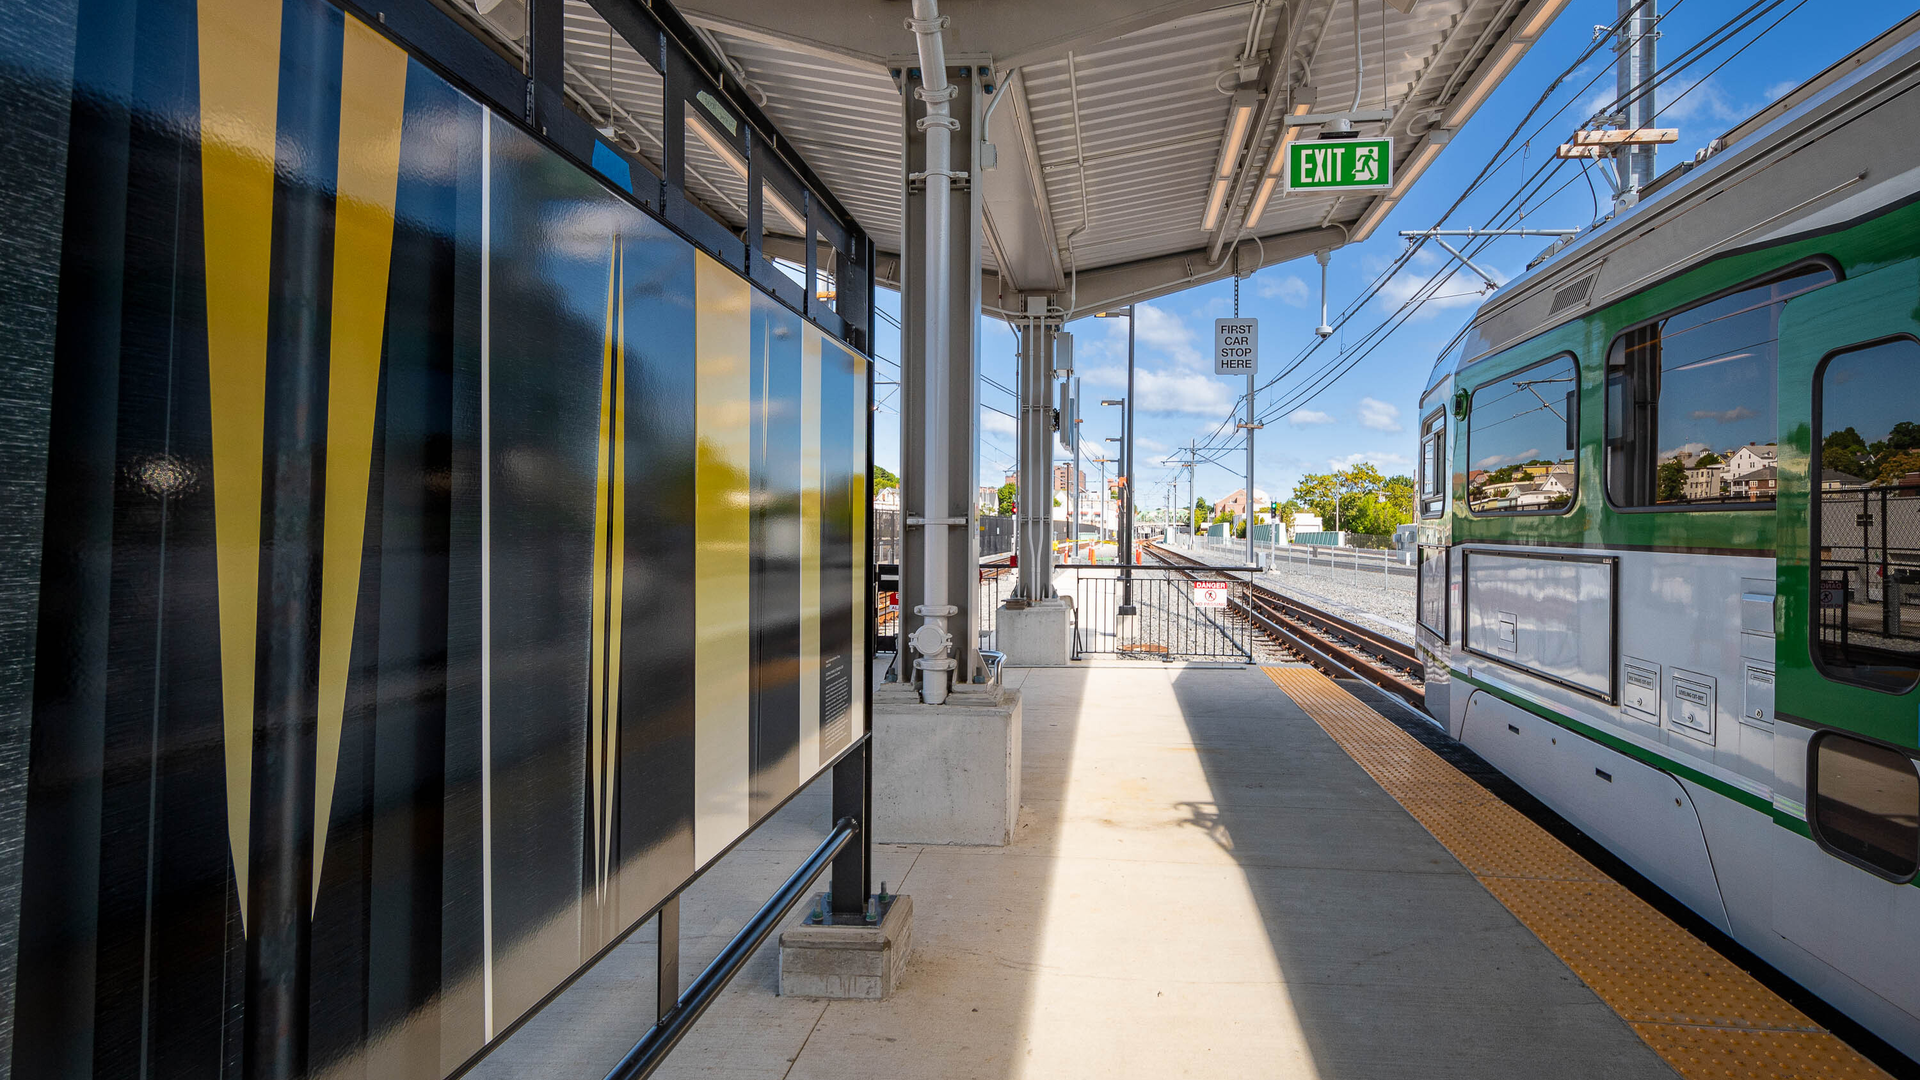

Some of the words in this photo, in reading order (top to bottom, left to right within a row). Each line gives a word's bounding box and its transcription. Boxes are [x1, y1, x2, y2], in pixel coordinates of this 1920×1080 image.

[1300, 148, 1345, 183] EXIT
[1221, 325, 1253, 334] FIRST
[1224, 337, 1249, 346] CAR
[1221, 347, 1252, 357] STOP
[1221, 360, 1252, 368] HERE
